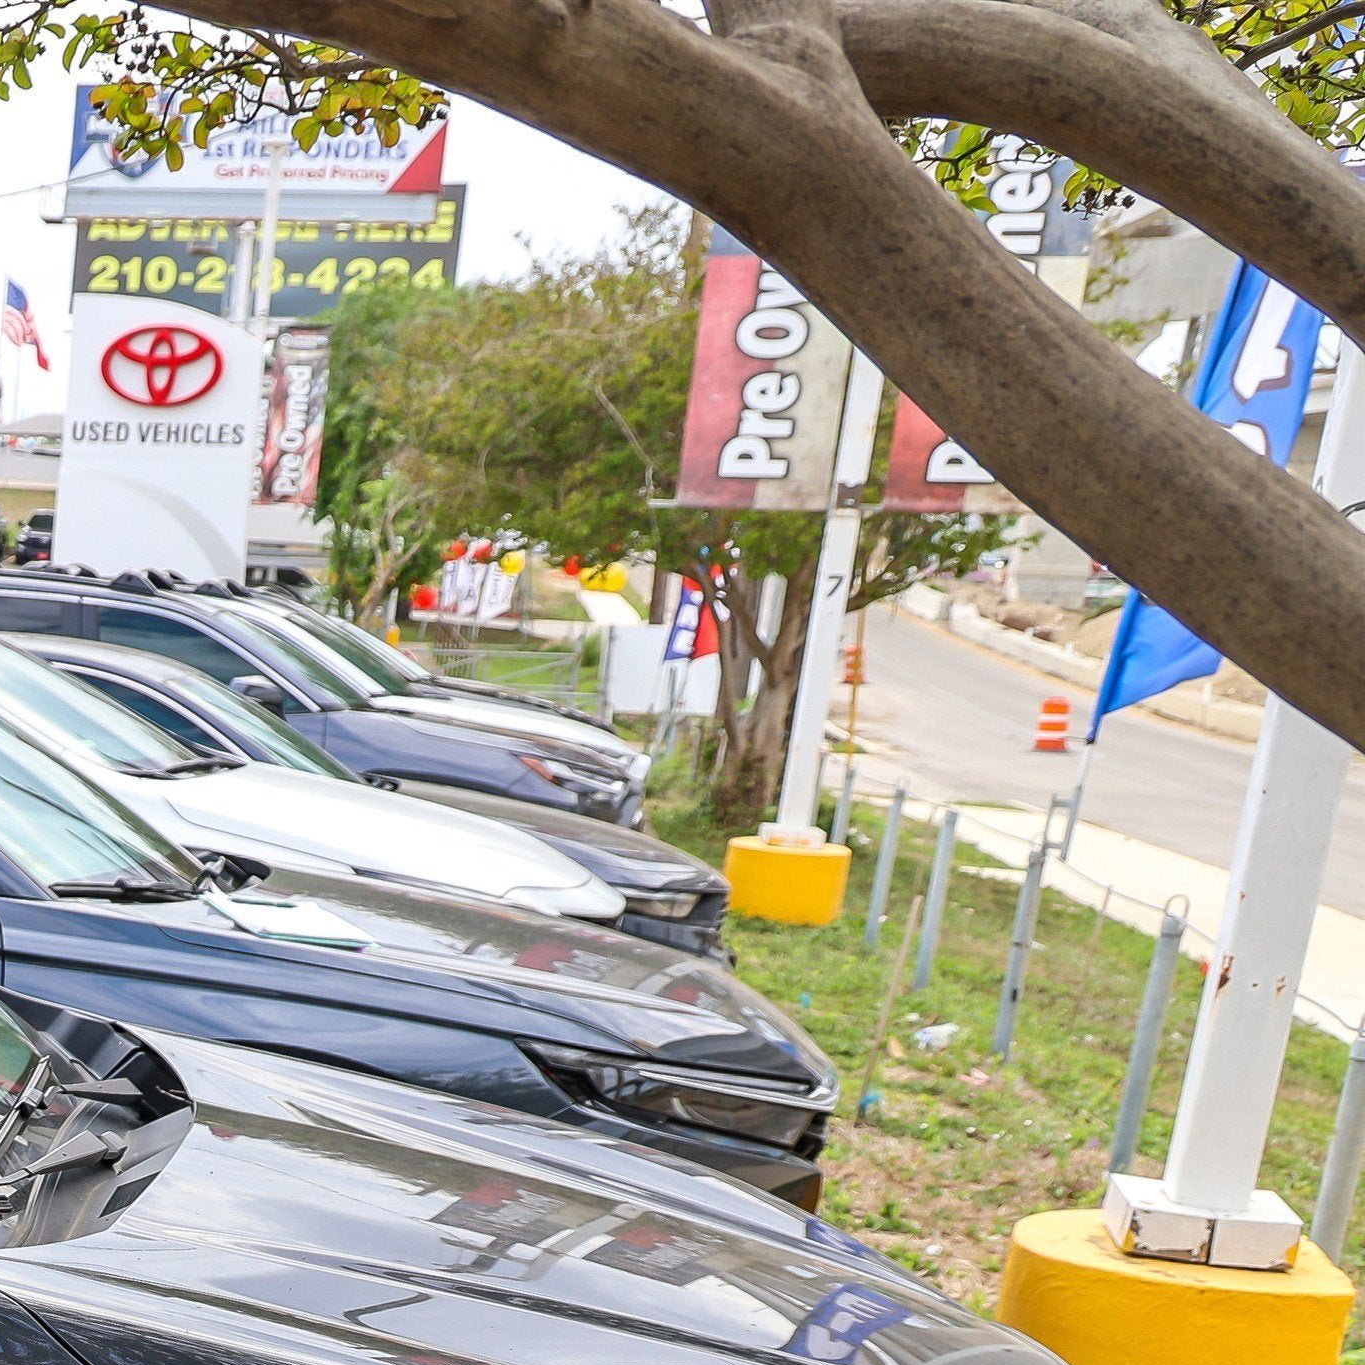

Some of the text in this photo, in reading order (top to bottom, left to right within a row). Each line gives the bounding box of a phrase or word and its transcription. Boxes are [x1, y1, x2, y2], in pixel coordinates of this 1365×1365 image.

[277, 364, 314, 452] Owned
[717, 371, 802, 481] Pre
[71, 420, 246, 445] USED VEHICLES
[271, 452, 304, 497] Pre
[827, 575, 845, 598] 7
